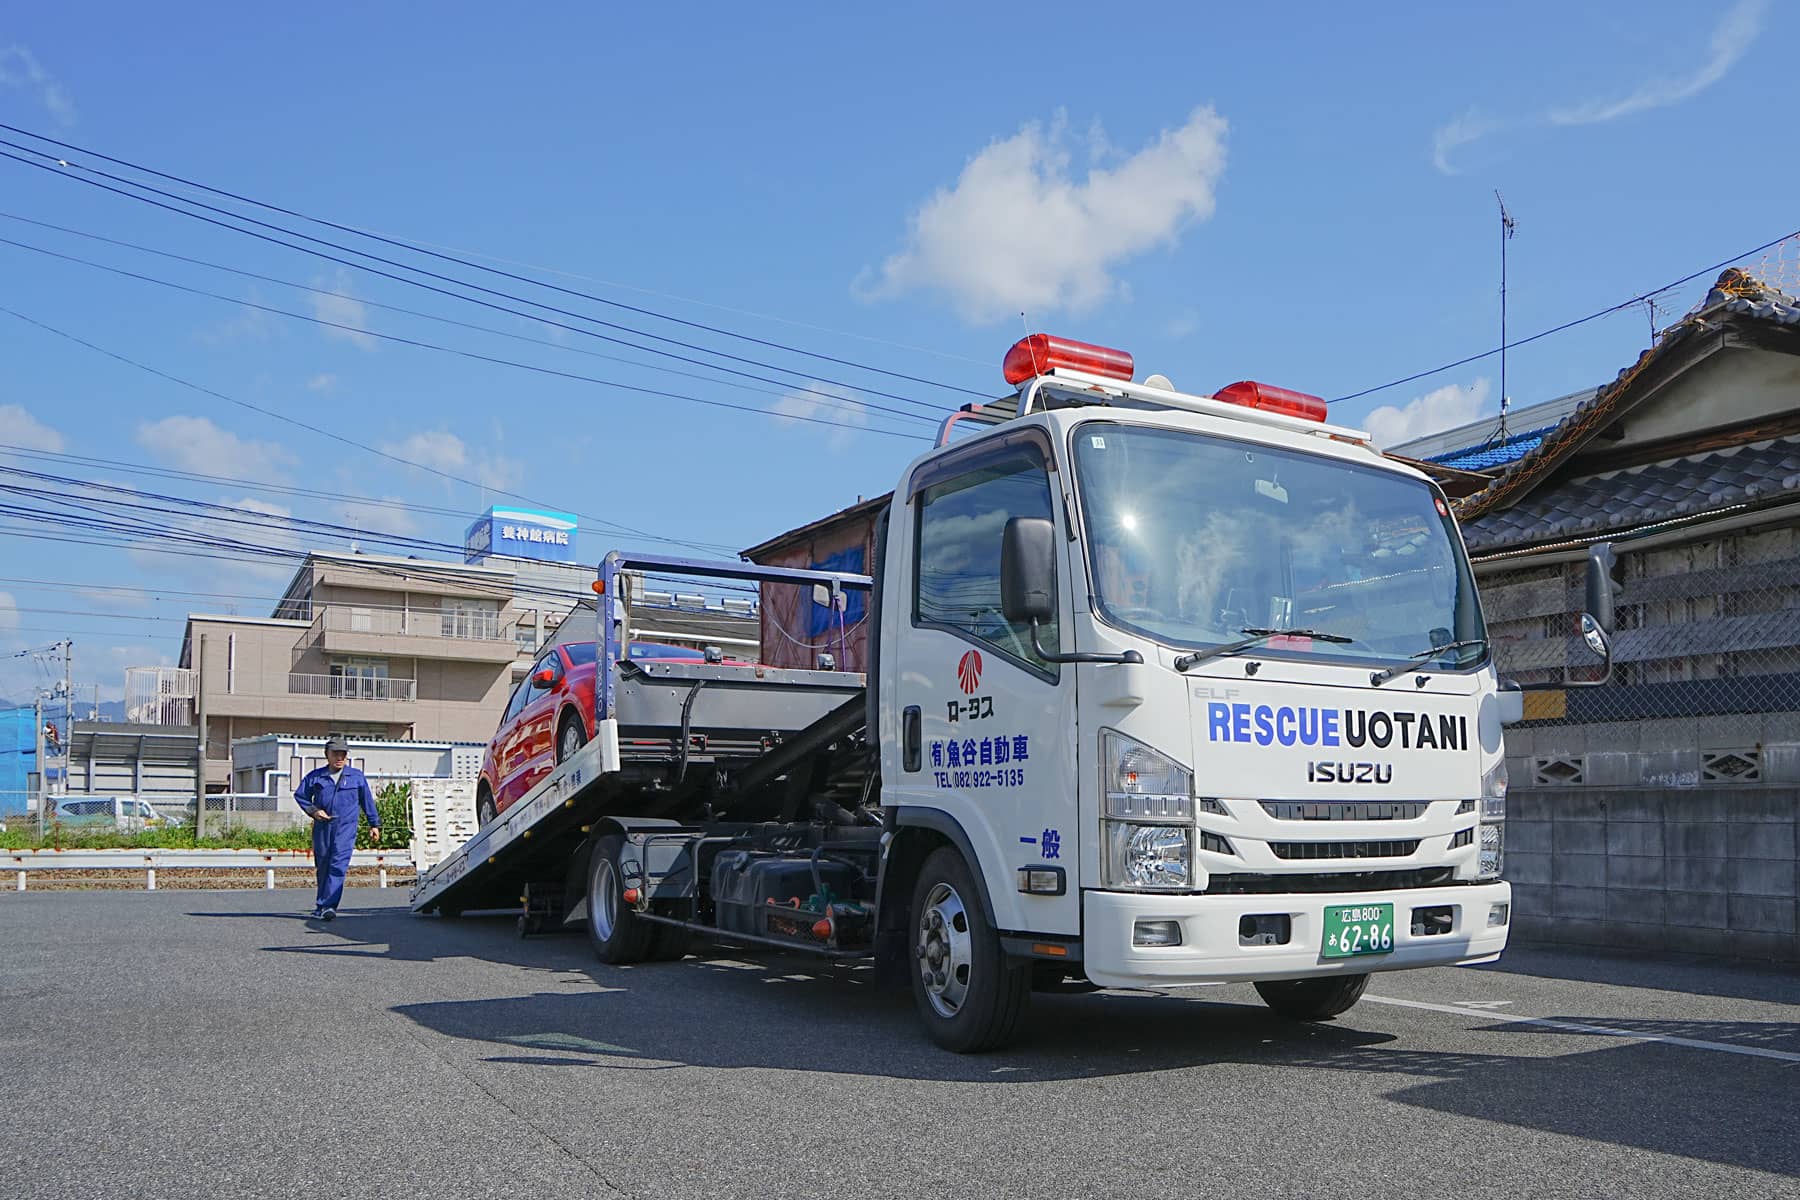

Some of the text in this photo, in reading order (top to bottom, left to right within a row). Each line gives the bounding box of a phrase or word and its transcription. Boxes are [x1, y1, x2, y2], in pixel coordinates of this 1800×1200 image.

[1194, 687, 1240, 699] ELF
[947, 696, 994, 722] ロータス
[1207, 702, 1468, 751] RESCUE UOTANI
[1308, 761, 1392, 784] ISUZU
[1019, 828, 1060, 859] 一般
[1340, 923, 1391, 952] 62-86
